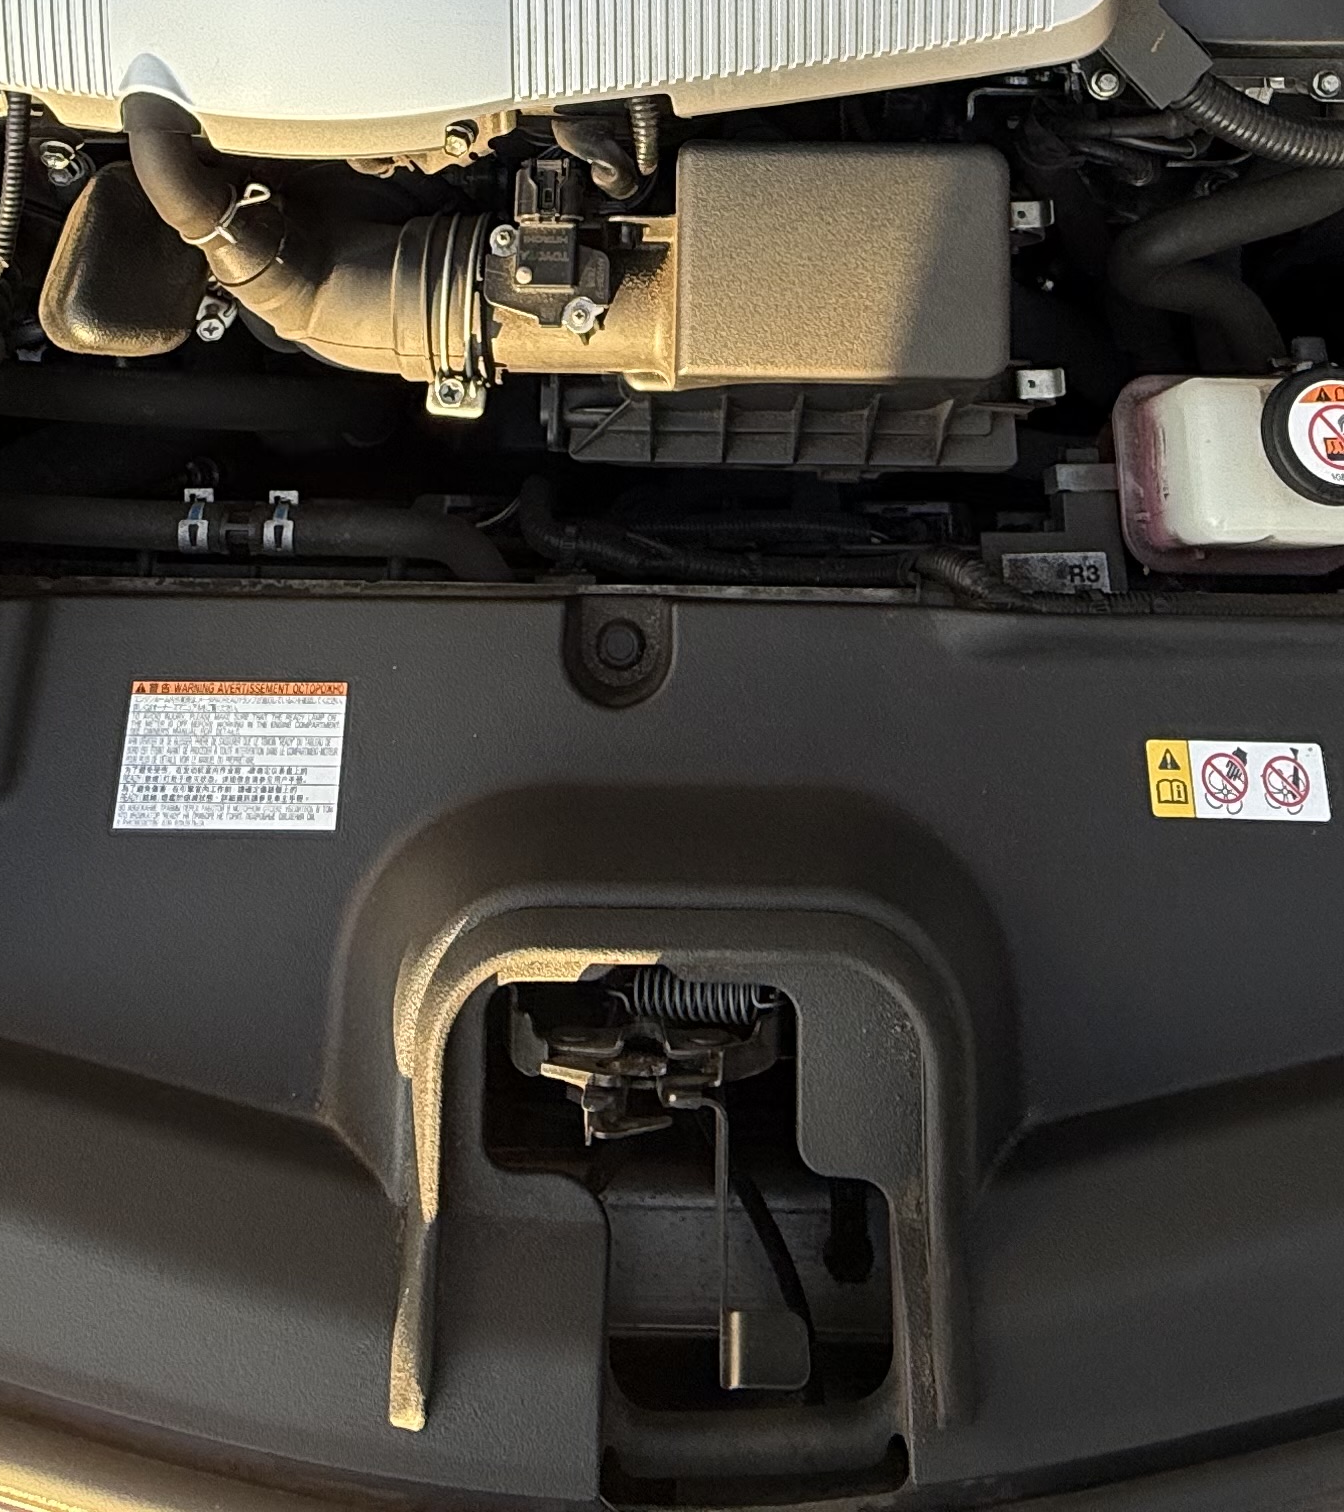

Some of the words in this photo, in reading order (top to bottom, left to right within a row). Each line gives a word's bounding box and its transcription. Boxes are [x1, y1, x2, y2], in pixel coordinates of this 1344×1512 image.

[520, 251, 570, 262] TOYOTA
[1068, 564, 1101, 583] R3
[174, 682, 215, 694] WARNING
[217, 682, 290, 694] AVERTISSEMENT
